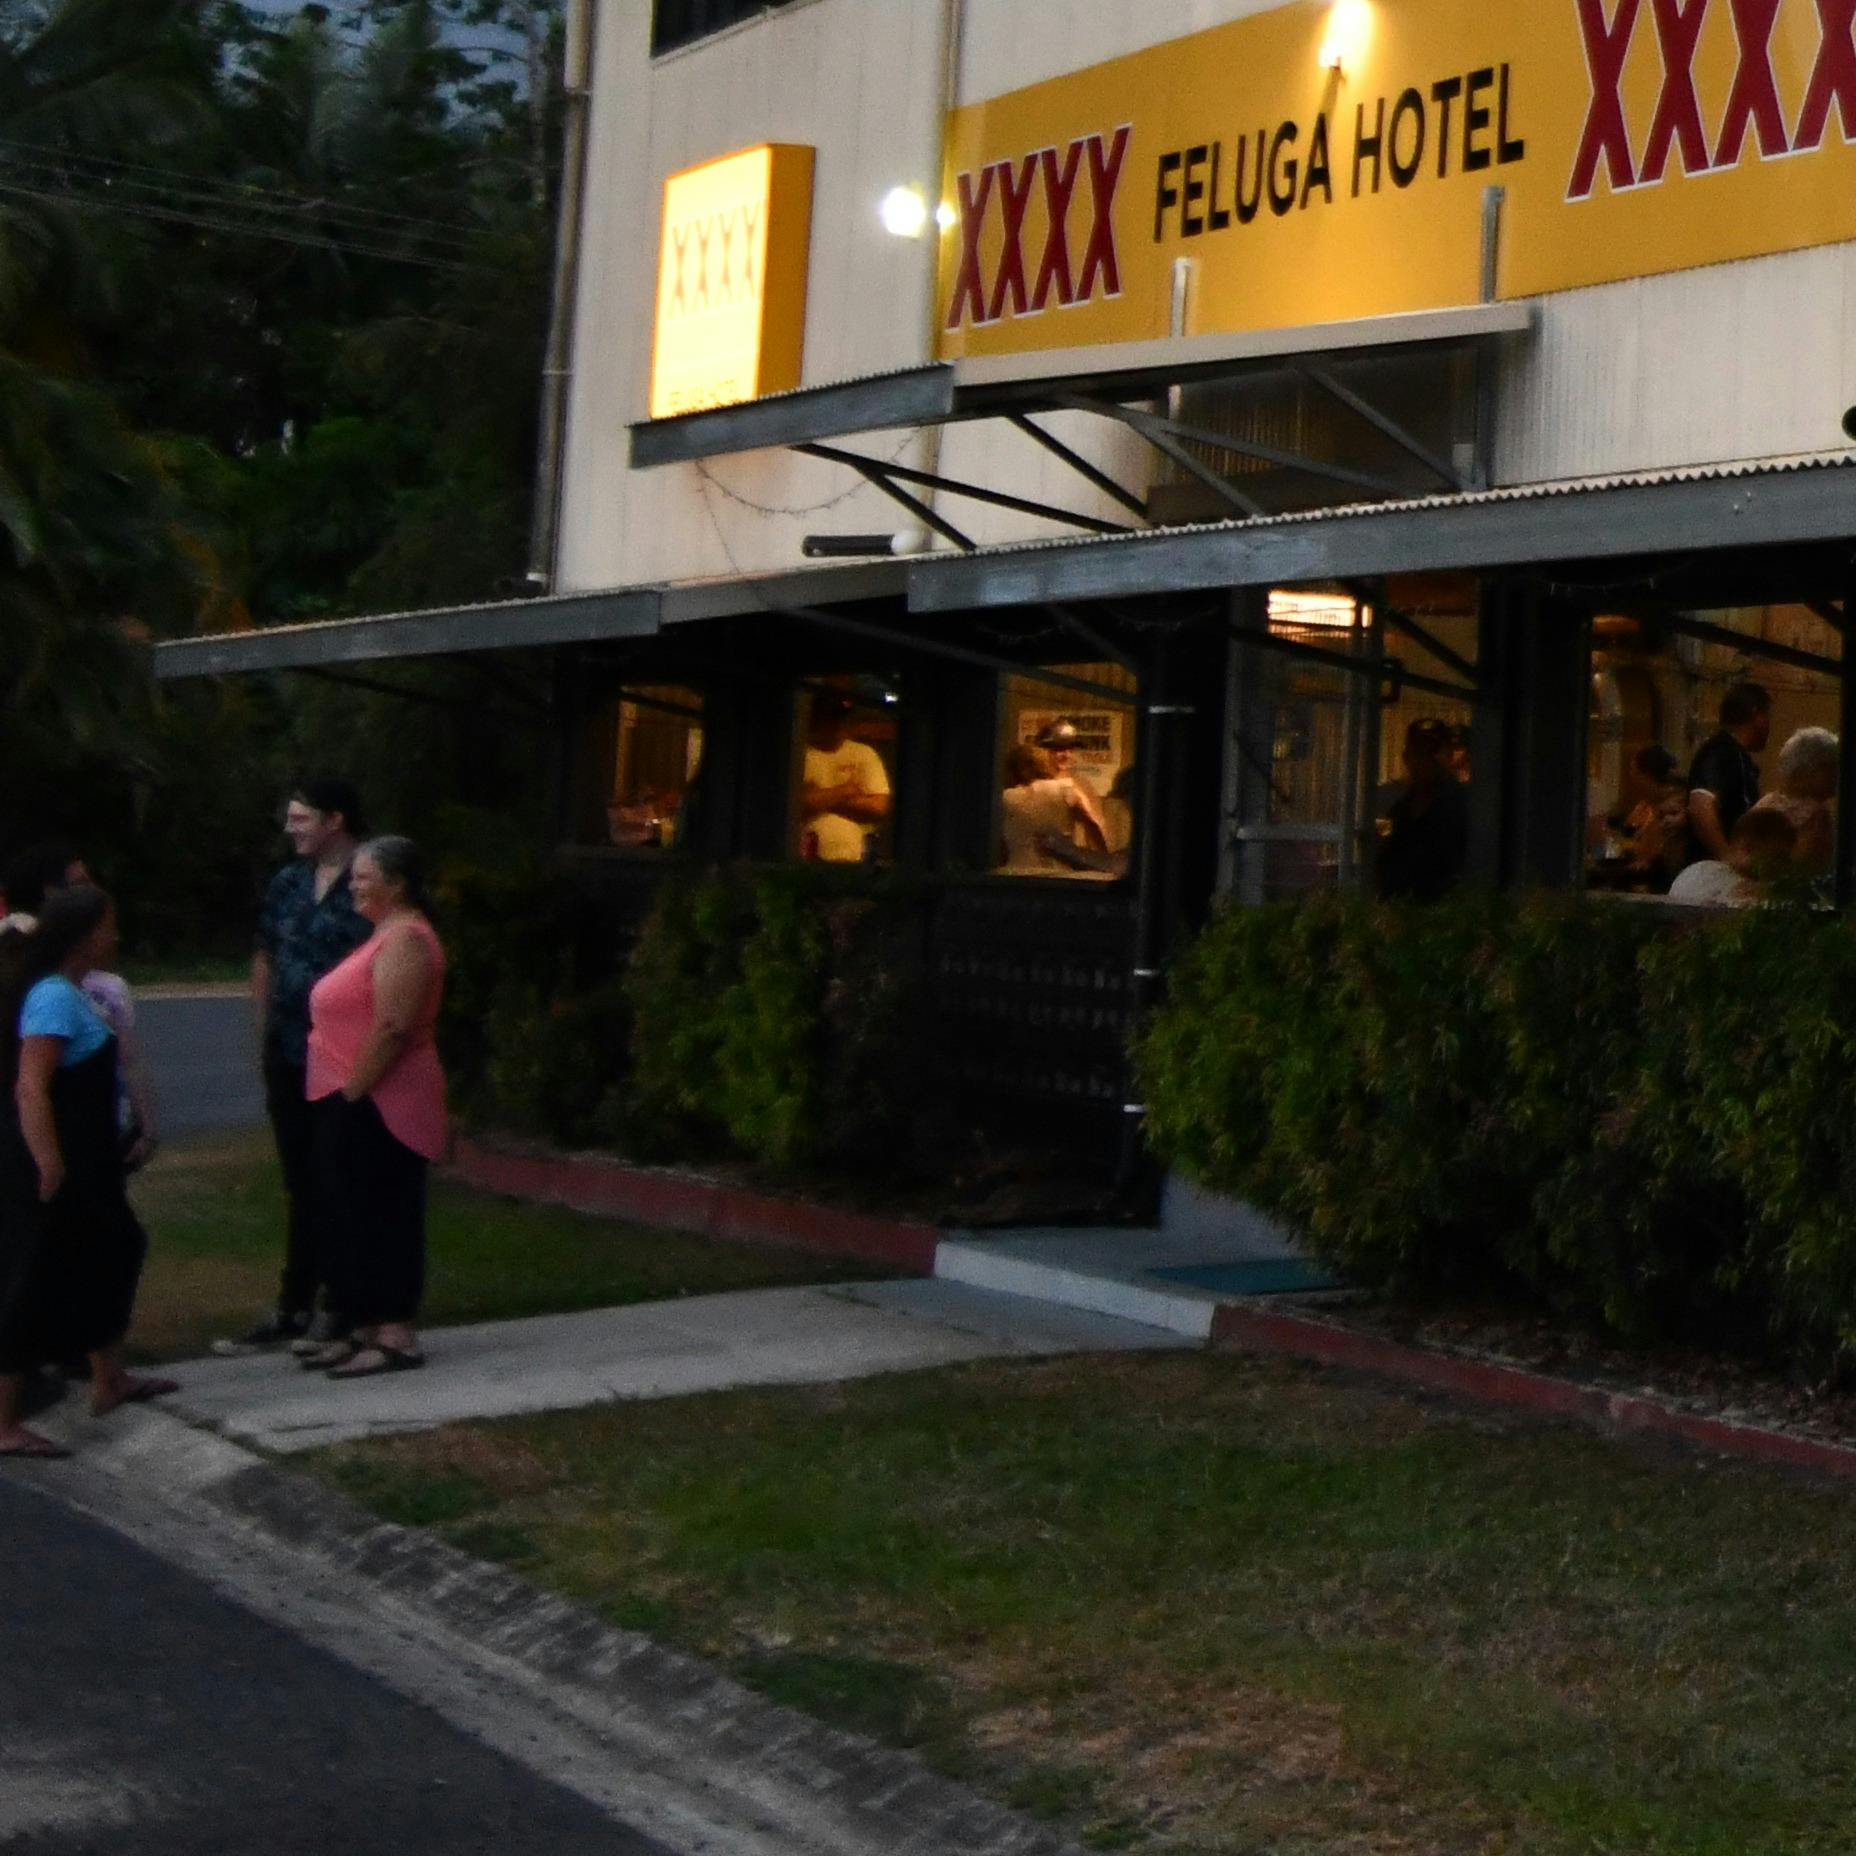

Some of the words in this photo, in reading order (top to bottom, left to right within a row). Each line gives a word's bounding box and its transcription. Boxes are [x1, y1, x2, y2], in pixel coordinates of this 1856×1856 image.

[668, 202, 761, 319] XXXX
[947, 122, 1134, 330] XXXX
[1153, 112, 1332, 242] FELUGA
[1353, 63, 1525, 196] HOTEL
